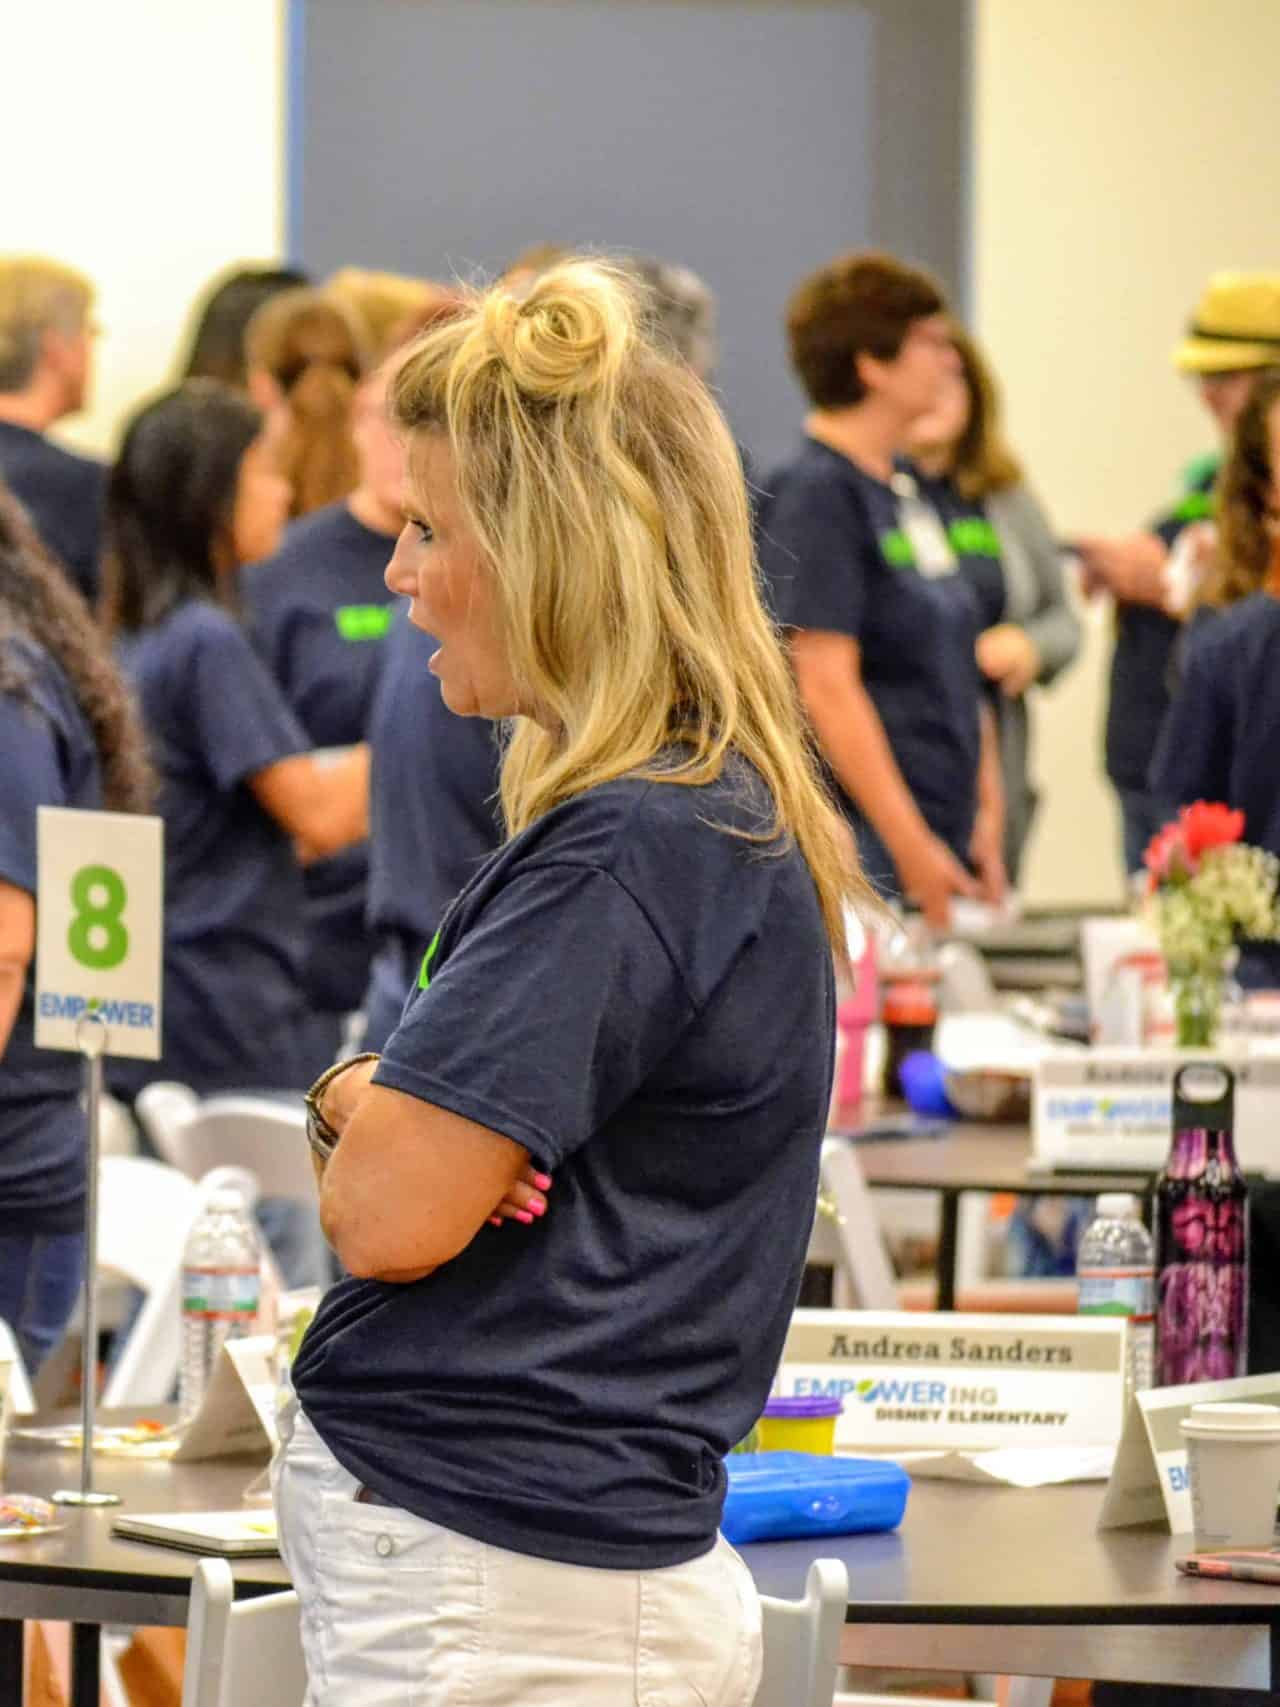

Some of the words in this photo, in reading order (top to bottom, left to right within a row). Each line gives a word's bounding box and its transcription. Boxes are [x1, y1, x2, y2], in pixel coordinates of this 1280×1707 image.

[67, 864, 129, 970] 8
[39, 992, 154, 1027] EMPOWER
[828, 1334, 941, 1360] Andrea
[949, 1337, 1073, 1364] Sanders
[875, 1407, 942, 1422] DISNEY
[947, 1409, 1069, 1426] ELEMENTARY
